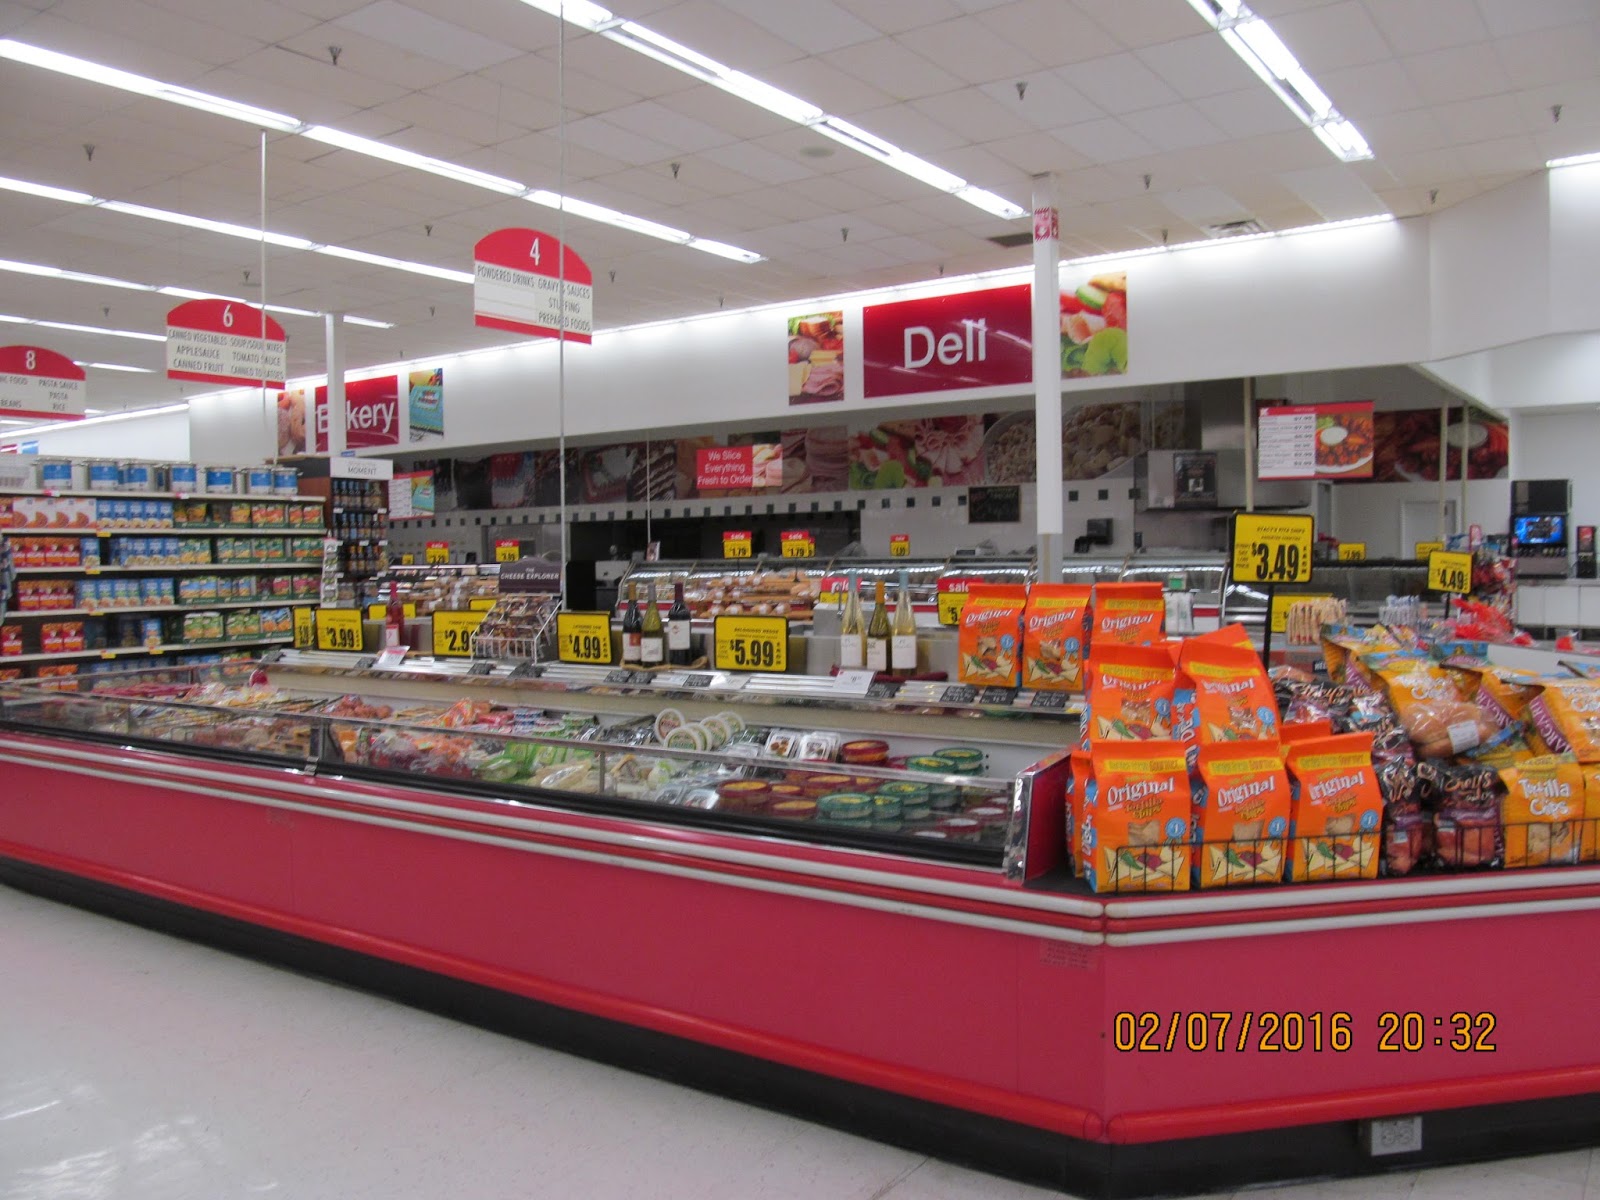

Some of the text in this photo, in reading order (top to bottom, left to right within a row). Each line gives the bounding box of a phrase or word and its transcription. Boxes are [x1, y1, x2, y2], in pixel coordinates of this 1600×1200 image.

[529, 237, 541, 266] 4
[477, 265, 535, 288] POWDERED DRINKS
[537, 278, 560, 293] GRAVY
[567, 285, 591, 300] SAUCES
[548, 297, 580, 314] STUFING
[222, 303, 234, 328] 6
[570, 318, 591, 332] FOODS
[168, 329, 228, 346] CANNED VEGETABLES
[904, 318, 987, 369] Deli
[25, 350, 37, 371] 8
[176, 345, 220, 359] APPLESAUCE
[232, 351, 260, 364] TOMATO
[173, 358, 225, 374] CANNED FRUIT
[231, 365, 255, 377] CANNED
[39, 379, 58, 389] PASTA
[49, 391, 69, 401] PASTA
[317, 400, 395, 434] Bkery
[708, 450, 742, 461] We Slice
[347, 466, 377, 476] MOMENT
[704, 463, 745, 475] Everything
[697, 474, 753, 486] Fresh to Order
[1252, 541, 1299, 582] $3.49
[526, 572, 559, 580] EXPLORER
[966, 609, 1013, 625] Original
[1029, 609, 1076, 628] Original
[1101, 613, 1154, 630] Original
[569, 634, 601, 659] $4.99
[730, 639, 774, 667] $5.99
[1107, 776, 1175, 806] Original
[1217, 775, 1275, 807] Original
